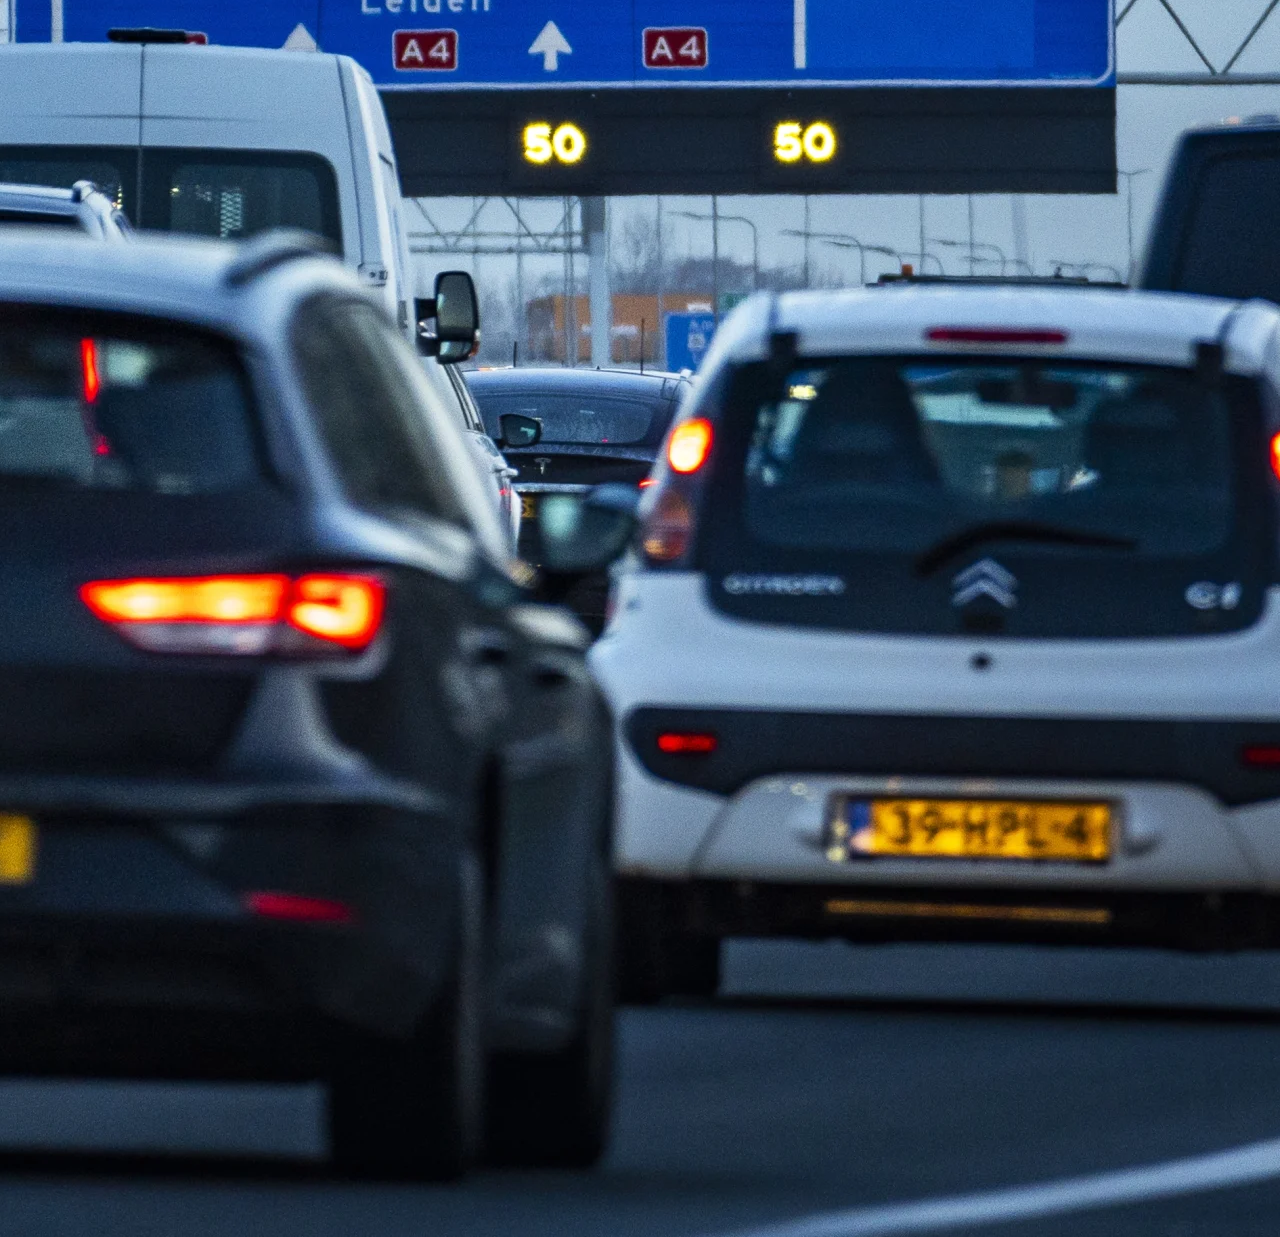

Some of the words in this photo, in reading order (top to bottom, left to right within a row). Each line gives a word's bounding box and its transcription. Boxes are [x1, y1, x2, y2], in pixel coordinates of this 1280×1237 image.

[400, 36, 451, 64] A4
[650, 34, 702, 62] A4
[521, 121, 588, 166] 50
[772, 120, 838, 164] 50
